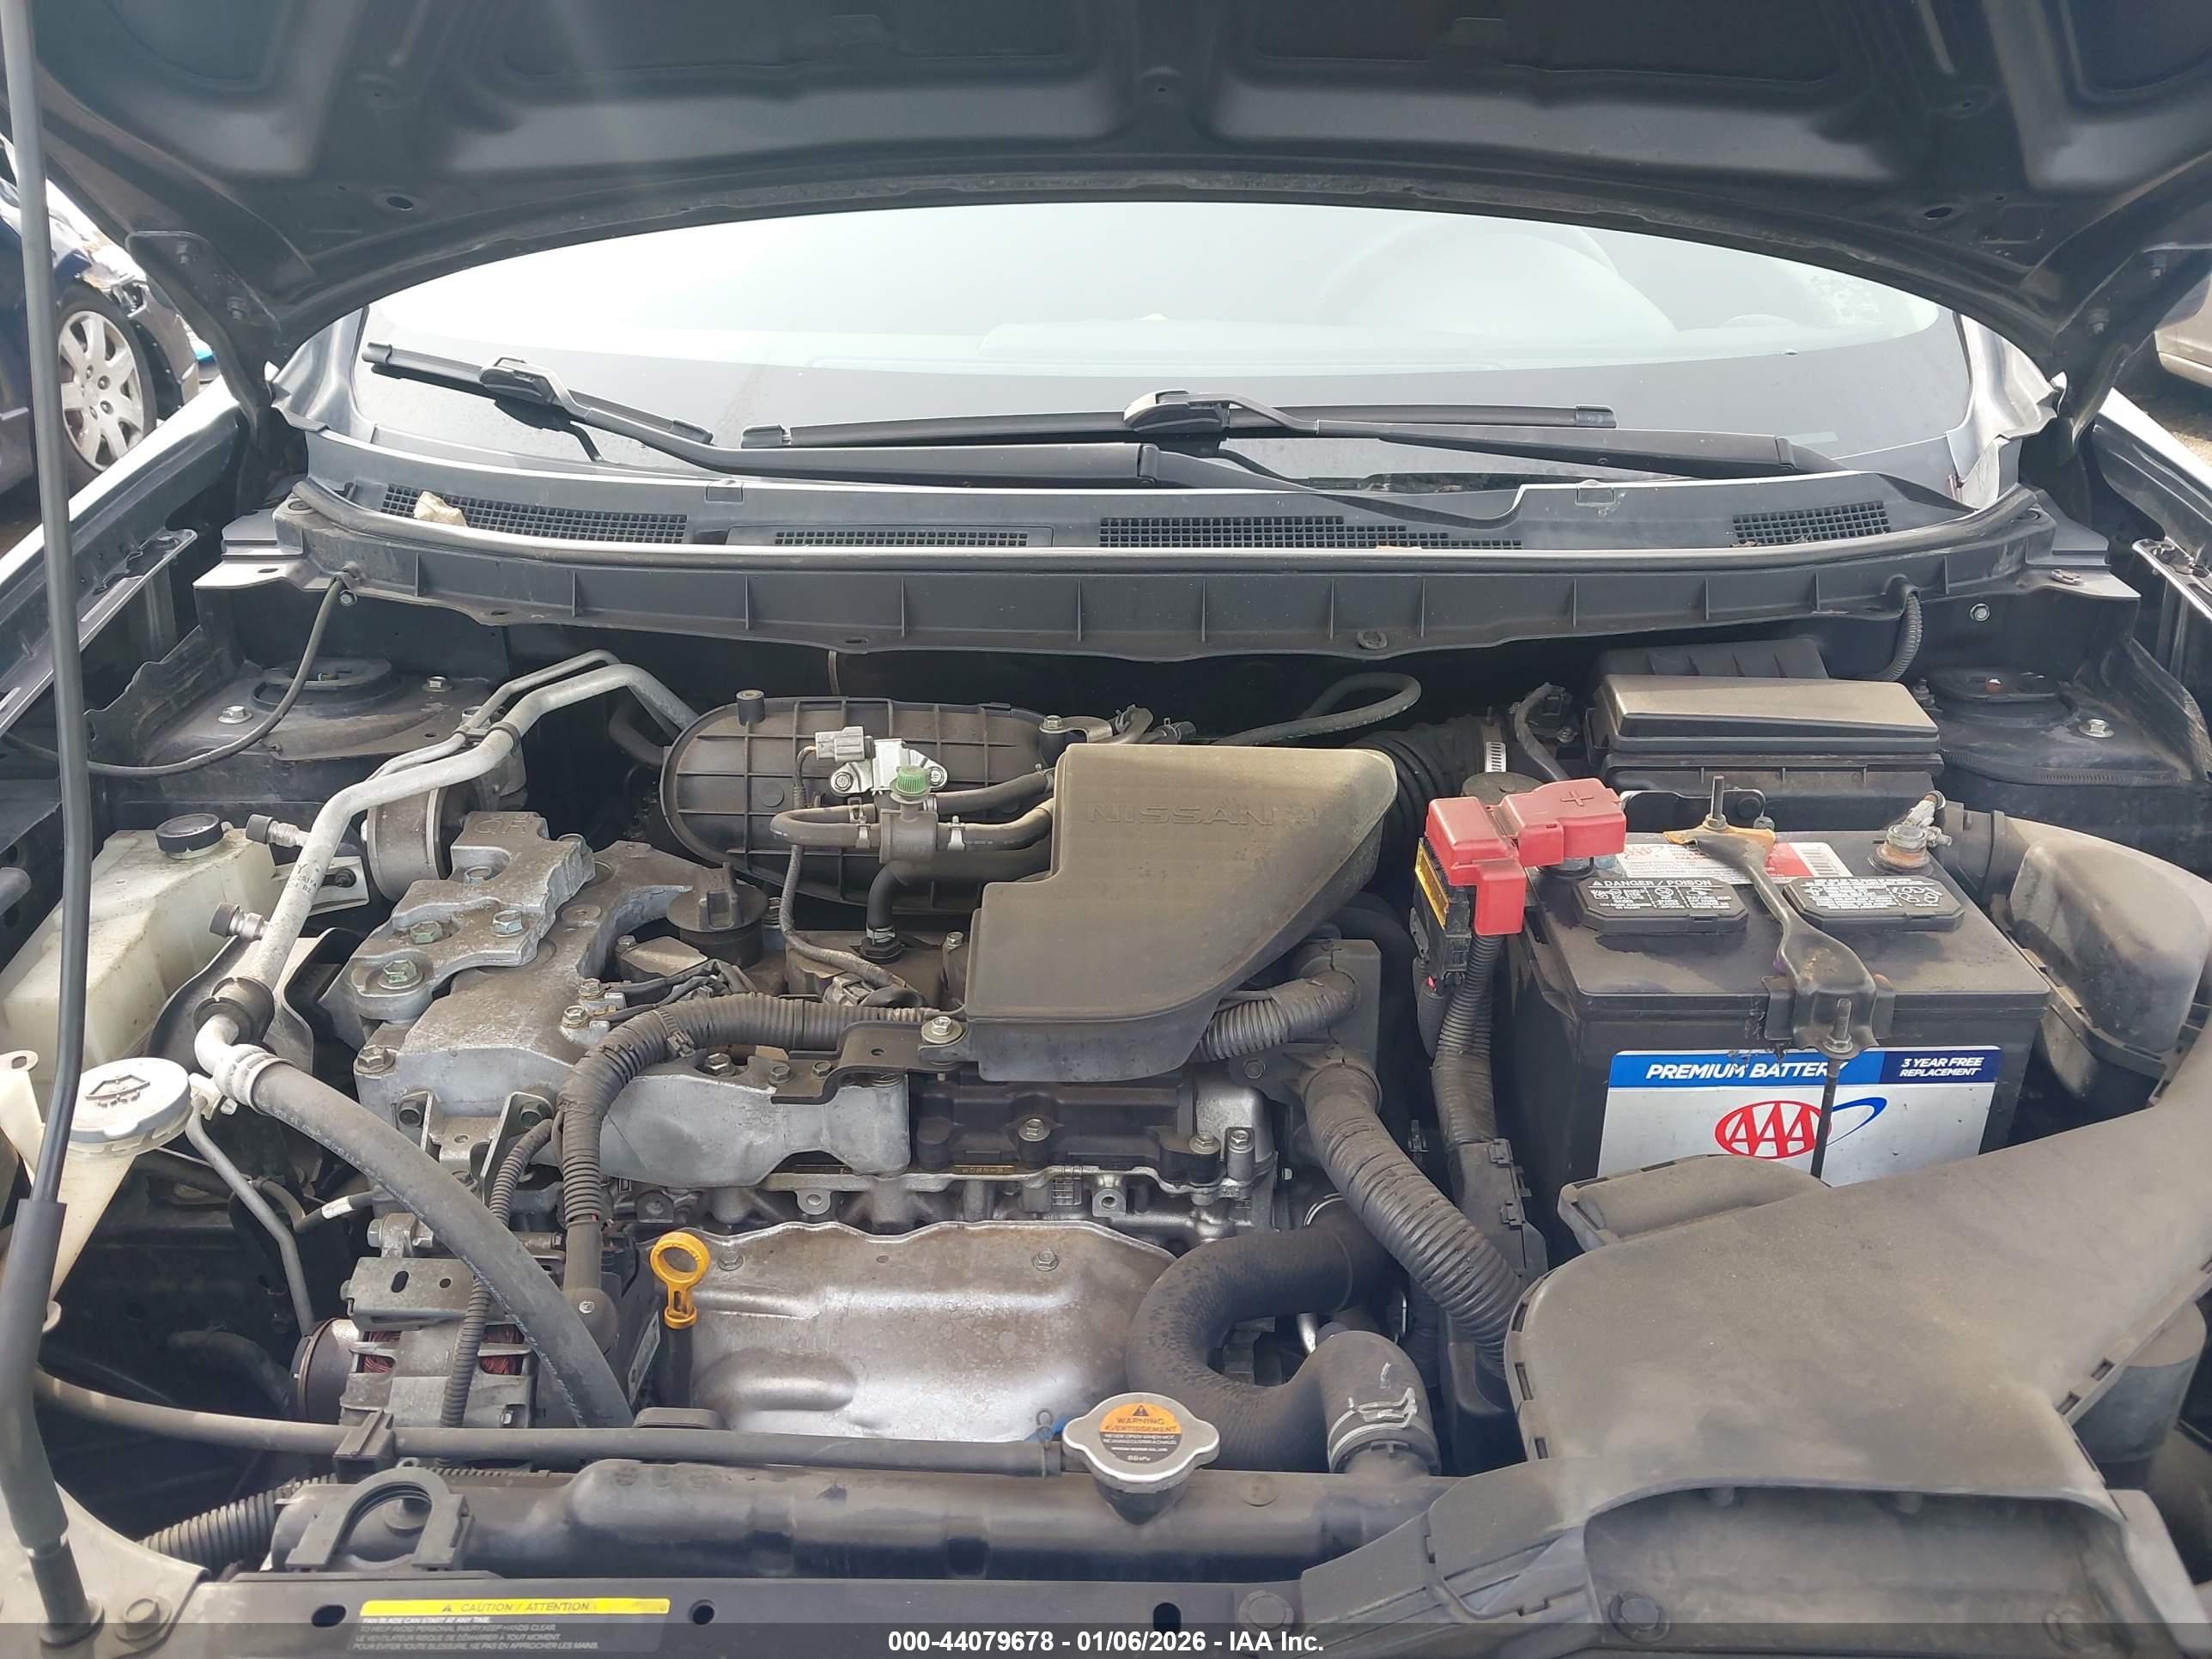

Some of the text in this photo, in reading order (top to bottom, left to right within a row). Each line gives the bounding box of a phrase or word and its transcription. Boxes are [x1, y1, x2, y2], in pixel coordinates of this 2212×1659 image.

[1086, 804, 1274, 825] NISSAN
[1901, 1057, 1985, 1067] 3 YEAR FREE
[1645, 1062, 1749, 1079] PREMIUM
[1899, 1067, 1980, 1078] REPLACEMENT
[1721, 1101, 1820, 1158] AAA
[460, 1601, 514, 1613] CAUTION
[525, 1601, 590, 1612] ATTENTION
